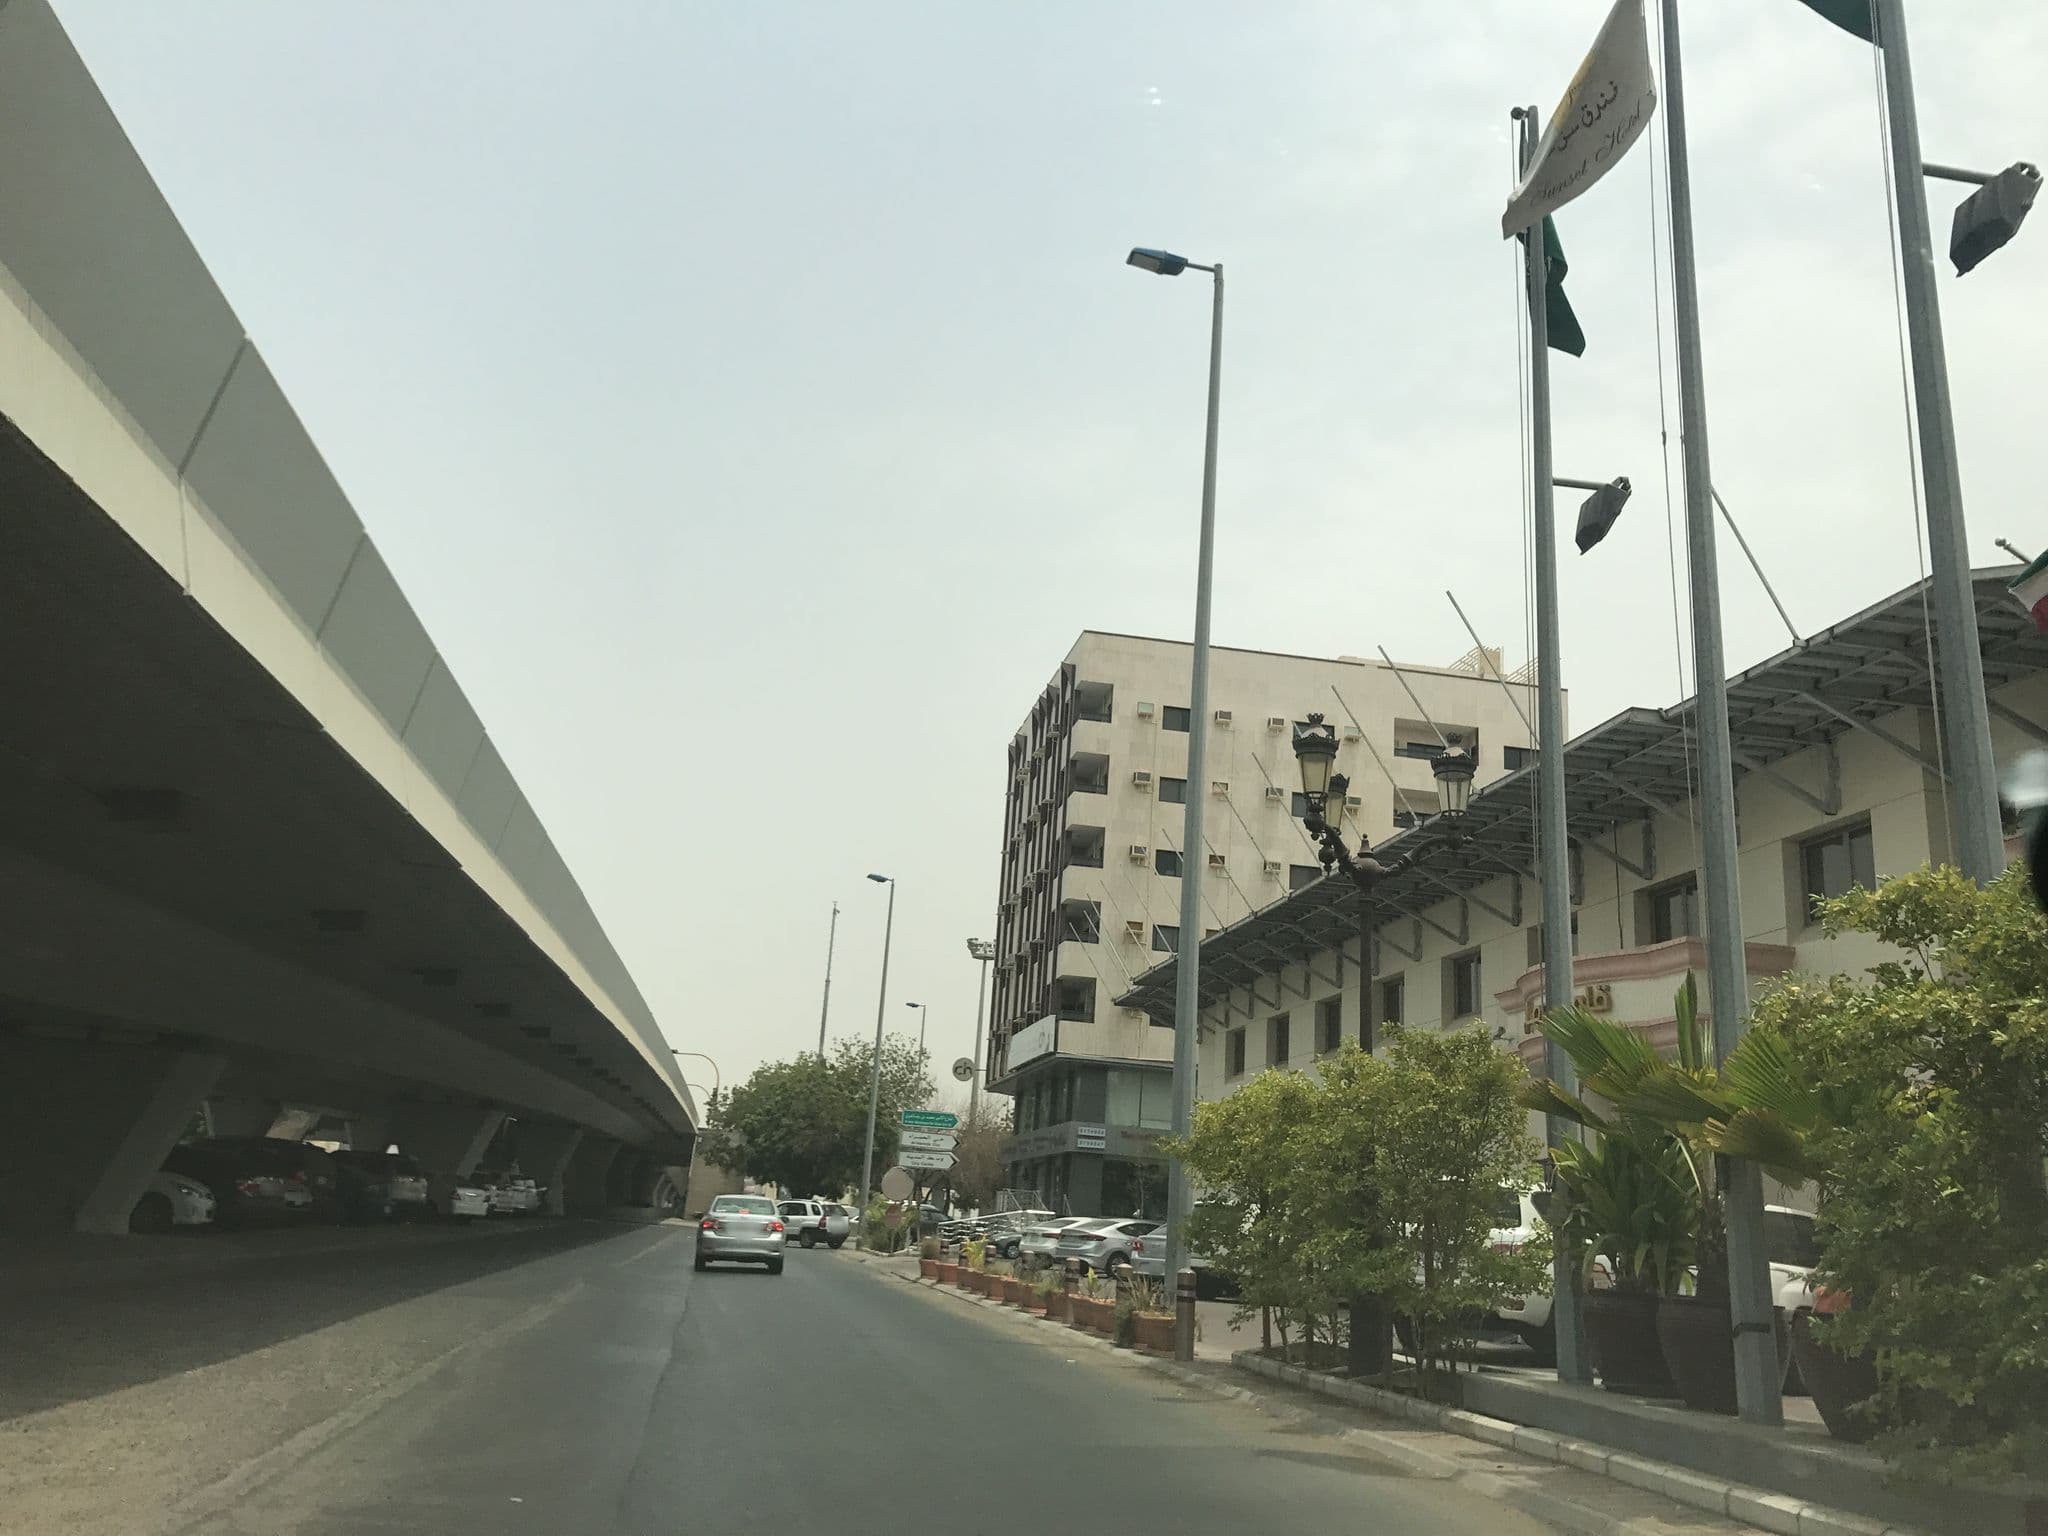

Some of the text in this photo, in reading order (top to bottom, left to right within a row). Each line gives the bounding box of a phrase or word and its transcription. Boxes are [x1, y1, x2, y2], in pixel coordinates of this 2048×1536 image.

[1581, 80, 1618, 127] فندق
[1530, 99, 1641, 207] Sunset Hotel
